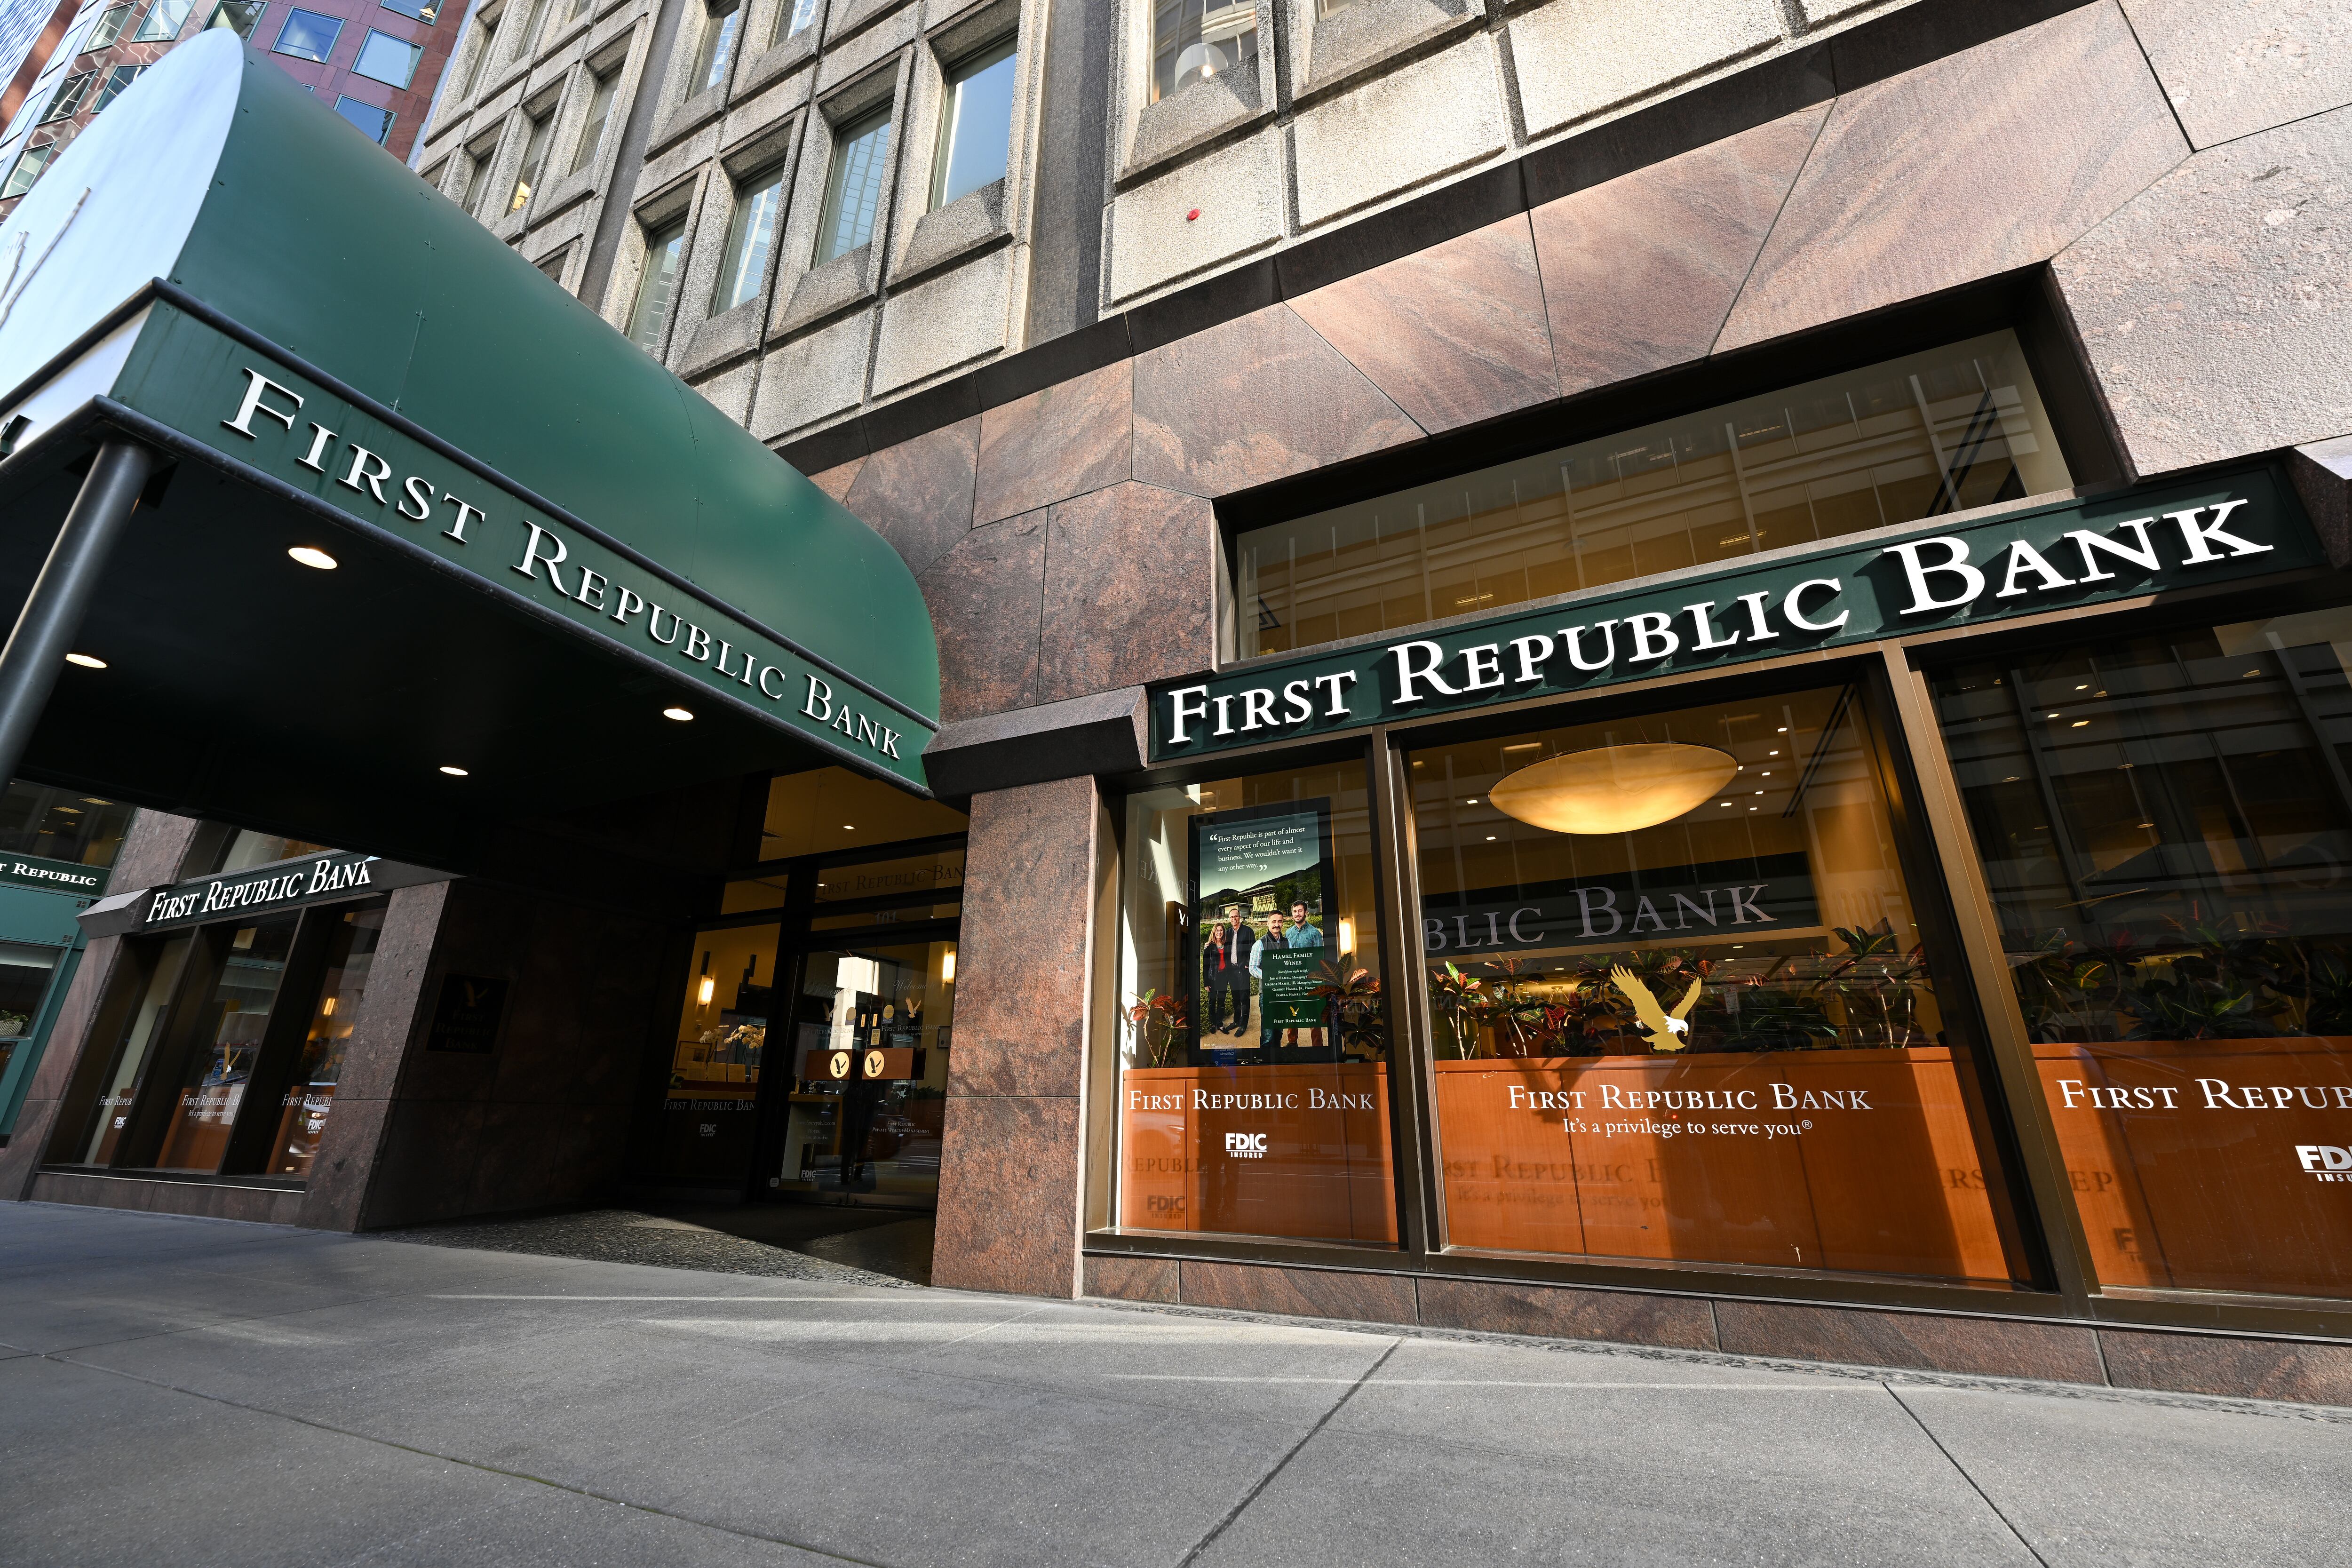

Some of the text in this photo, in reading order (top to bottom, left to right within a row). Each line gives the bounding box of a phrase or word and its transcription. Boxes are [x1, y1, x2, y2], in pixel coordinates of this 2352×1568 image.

[223, 367, 902, 760] FIRST REPUBLIC BANK
[1168, 499, 2274, 744] FIRST REPUBLIC BANK
[1232, 832, 1256, 842] Republic
[11, 863, 97, 886] REPUBLIC
[855, 870, 926, 891] REPUBLIC
[145, 892, 200, 923] FIRST
[200, 873, 304, 913] REPUBLIC
[875, 910, 897, 926] 101
[1569, 883, 1778, 939] BANK
[99, 1096, 114, 1106] FIRST
[181, 1094, 199, 1106] FIRST
[199, 1094, 231, 1106] REPUBLIC
[281, 1094, 303, 1106] FIRST
[1129, 1088, 1375, 1110] FIRST REPUBLIC BANK
[1507, 1083, 1873, 1110] FIRST REPUBLIC BANK
[2056, 1079, 2352, 1109] FIRST REPUB
[663, 1099, 687, 1110] FIRST
[690, 1099, 733, 1110] REPUBLIC
[308, 1120, 324, 1130] FDIC
[699, 1124, 717, 1133] FDIC
[1563, 1118, 1586, 1133] It’s
[1592, 1122, 1600, 1133] a
[1605, 1118, 1681, 1138] privilege
[1687, 1122, 1706, 1134] to
[1711, 1122, 1759, 1134] serve
[1225, 1133, 1267, 1151] FDIC
[801, 1170, 816, 1178] FDIC
